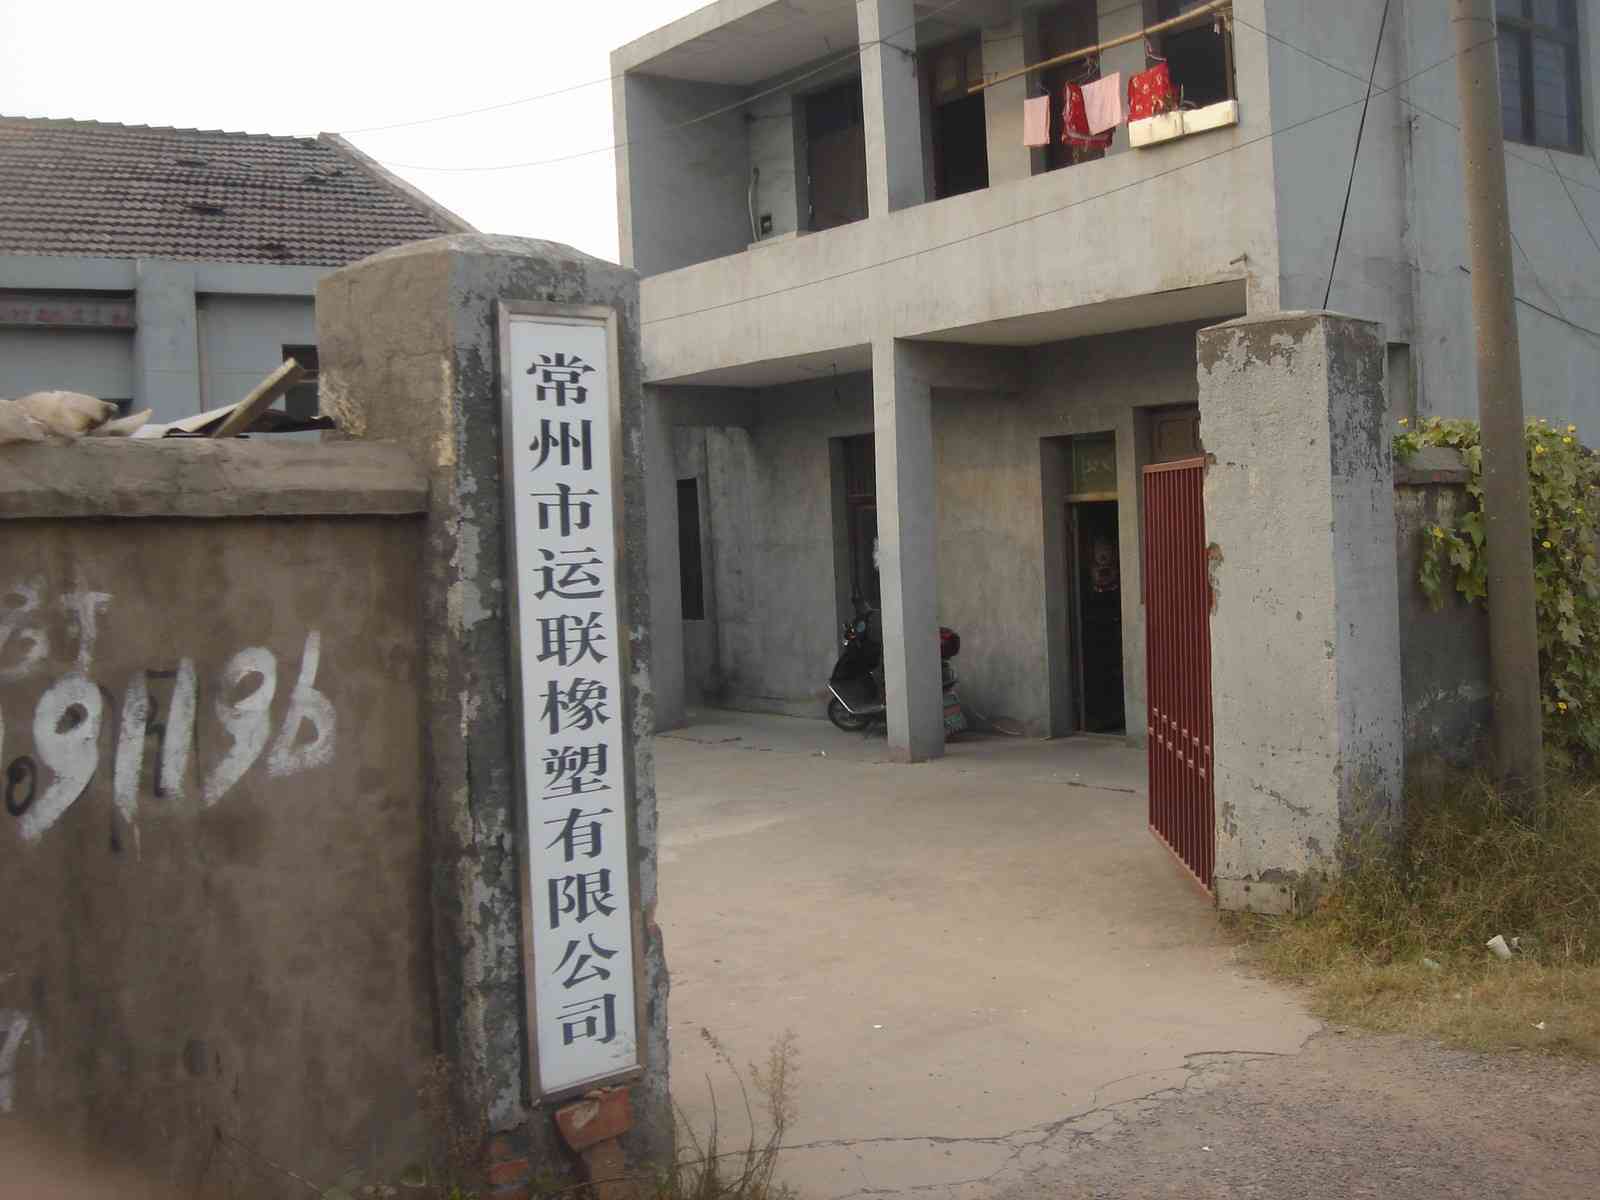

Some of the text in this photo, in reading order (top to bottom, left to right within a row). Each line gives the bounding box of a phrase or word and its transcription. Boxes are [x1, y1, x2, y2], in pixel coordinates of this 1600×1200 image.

[526, 352, 619, 1046] 常州市运联橡塑有限公司
